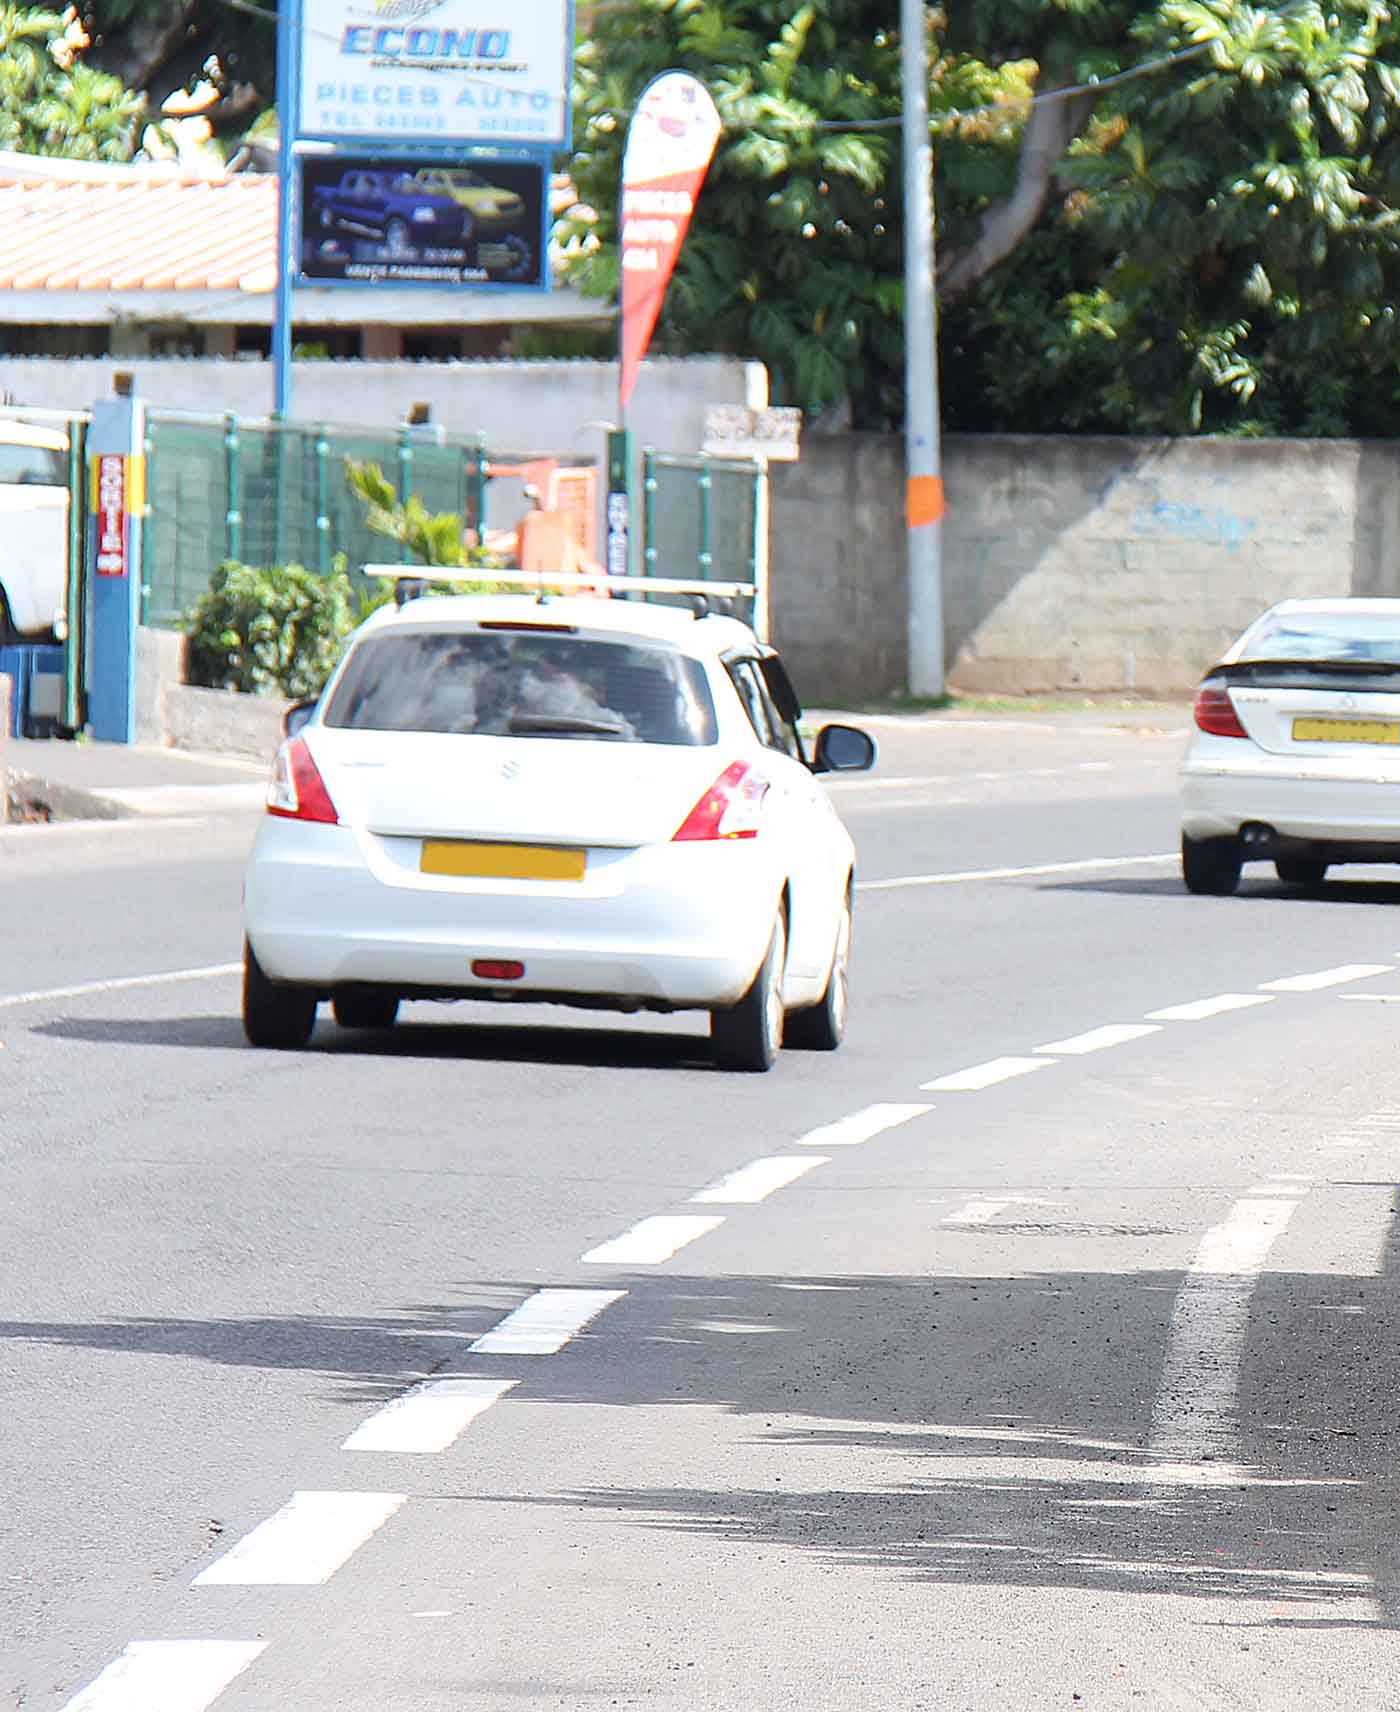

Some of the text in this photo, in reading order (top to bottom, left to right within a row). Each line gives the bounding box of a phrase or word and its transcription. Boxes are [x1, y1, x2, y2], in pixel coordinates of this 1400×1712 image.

[340, 24, 512, 58] ECONO
[316, 83, 550, 111] PIECES AUTO
